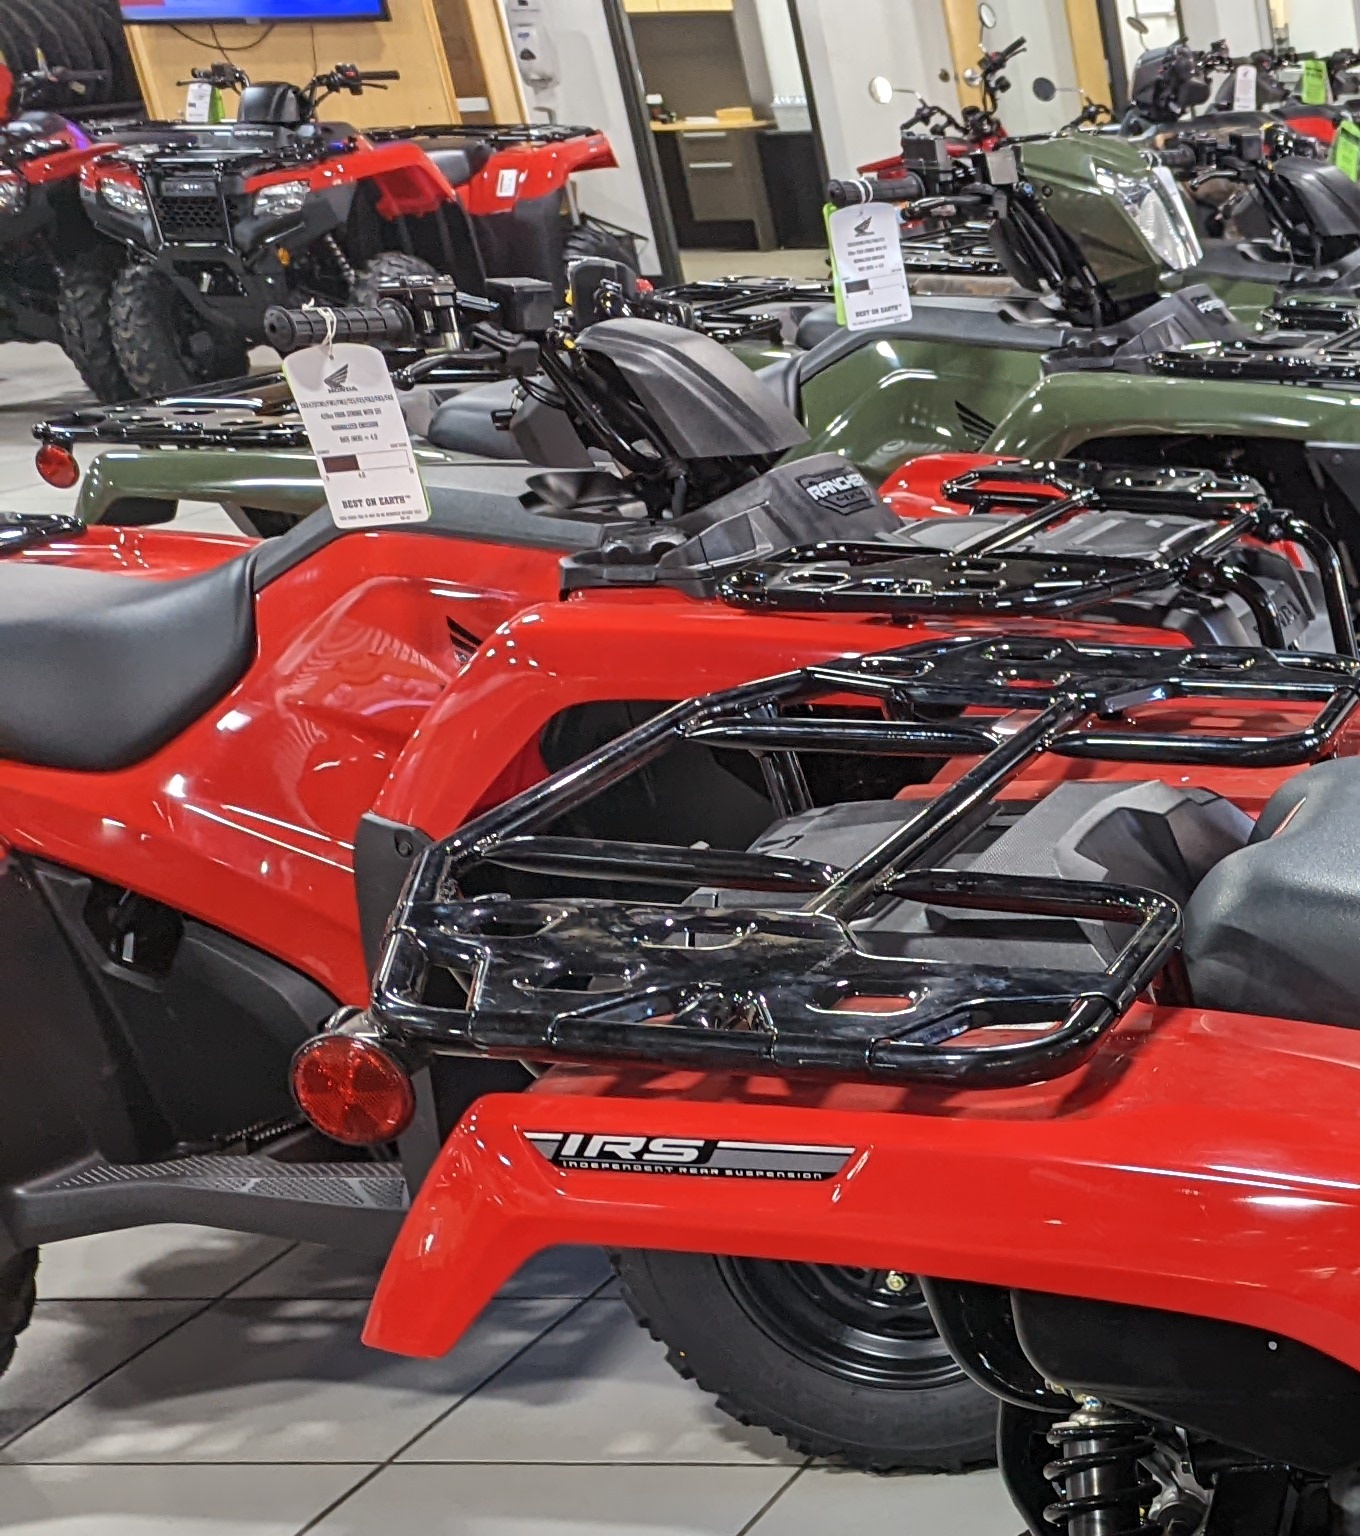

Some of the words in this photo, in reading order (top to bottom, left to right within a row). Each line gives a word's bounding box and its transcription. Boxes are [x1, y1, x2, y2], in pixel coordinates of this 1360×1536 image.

[342, 499, 364, 509] BEST
[365, 497, 377, 507] ON
[560, 1134, 705, 1163] IRS
[562, 1160, 674, 1175] INDEPENDENT
[678, 1166, 719, 1176] REAR
[725, 1169, 823, 1181] SUSPENSION
